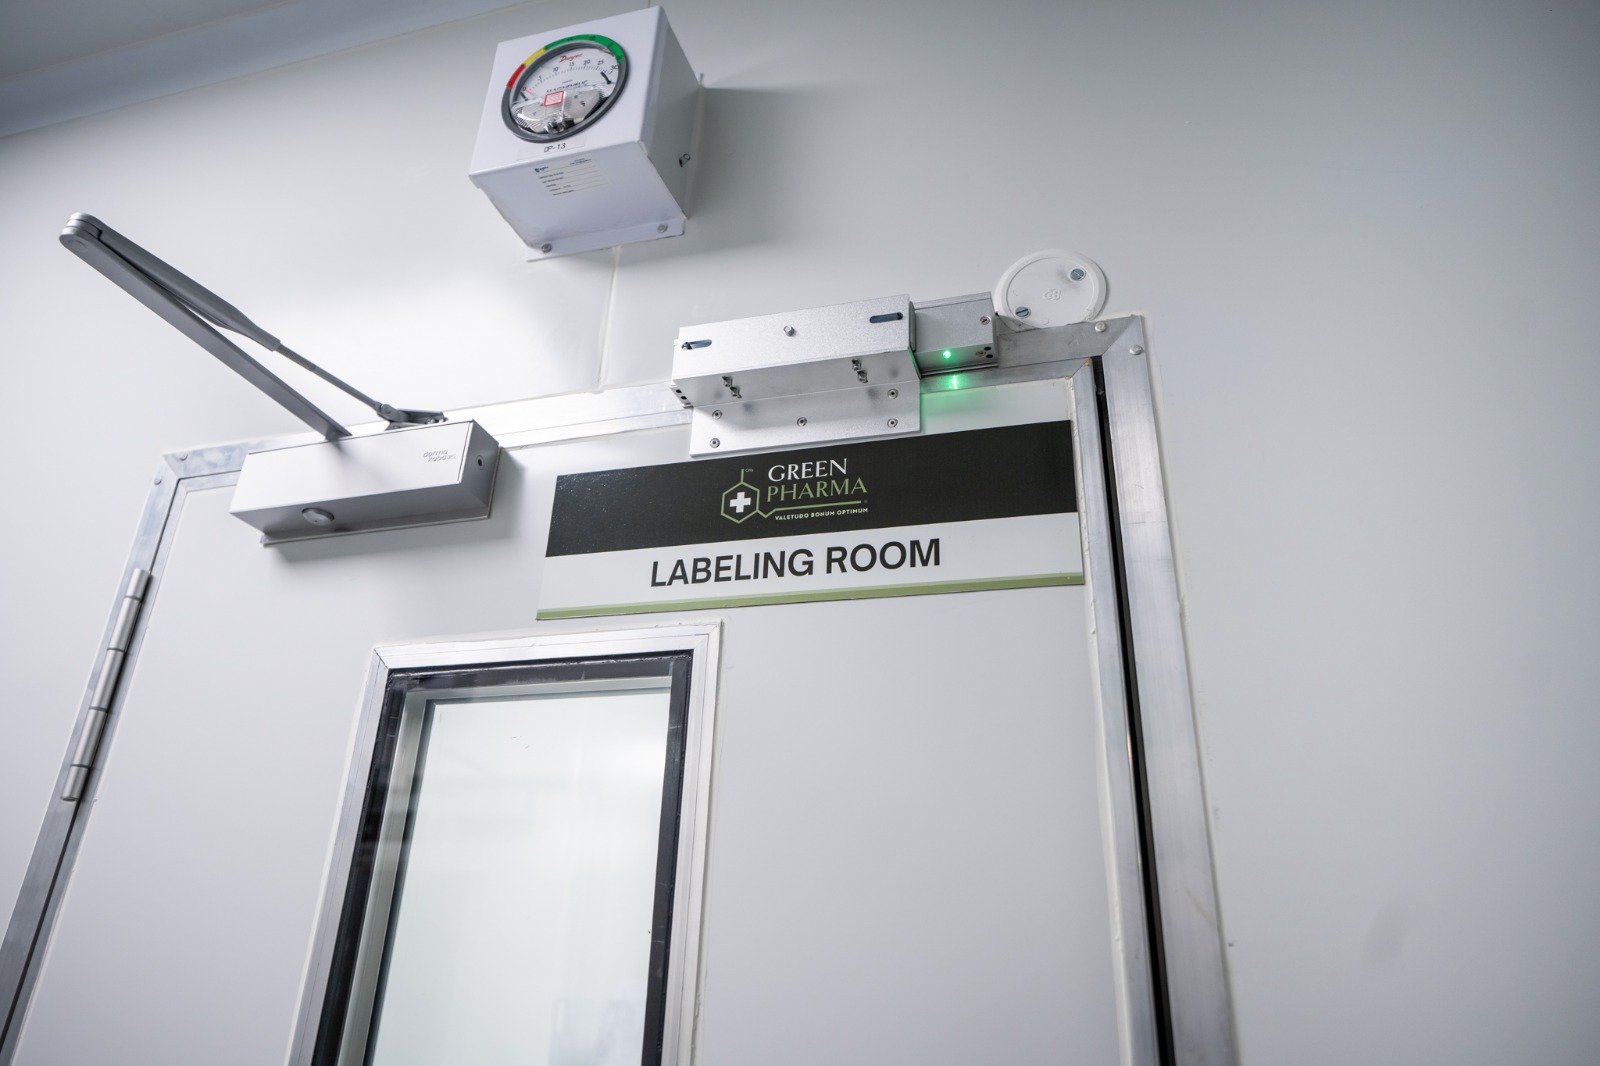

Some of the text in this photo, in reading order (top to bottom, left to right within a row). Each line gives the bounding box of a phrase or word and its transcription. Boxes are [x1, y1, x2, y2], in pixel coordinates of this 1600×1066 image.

[768, 458, 847, 482] GREEN
[767, 477, 868, 502] PHARMA
[775, 507, 869, 521] VALETUDO BONUM OPTIMUM
[650, 538, 941, 587] LABELING ROOM
